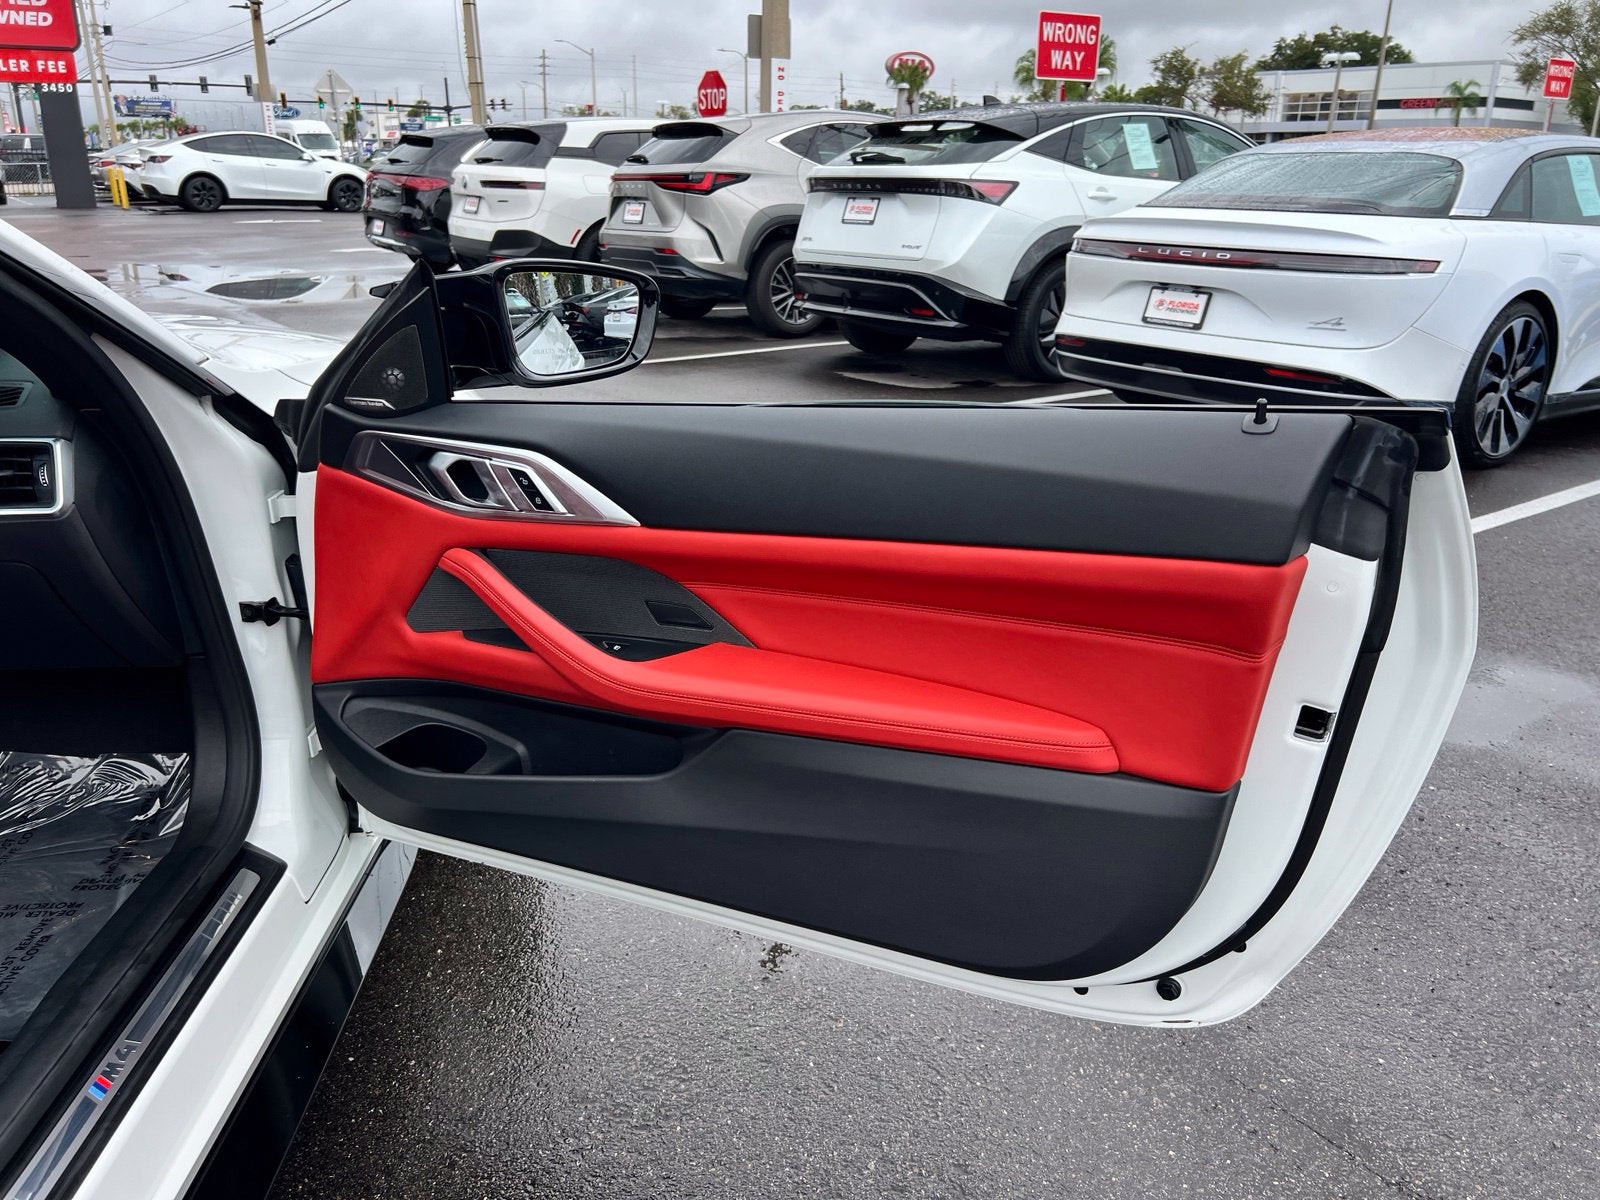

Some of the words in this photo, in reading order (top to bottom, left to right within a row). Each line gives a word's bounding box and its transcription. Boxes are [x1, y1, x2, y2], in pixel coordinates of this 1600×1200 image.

[1042, 21, 1097, 45] WRONG
[36, 60, 67, 73] FEE
[1051, 49, 1085, 71] WAY
[1548, 64, 1573, 78] WRONG
[41, 83, 73, 93] 3450
[1549, 80, 1567, 93] WAY
[699, 88, 726, 110] STOP
[1137, 247, 1231, 259] LUCID
[1168, 300, 1200, 310] FLORIDA
[2, 901, 85, 911] PROTECTIVE
[25, 909, 77, 918] DEALER
[100, 1044, 139, 1083] M4
